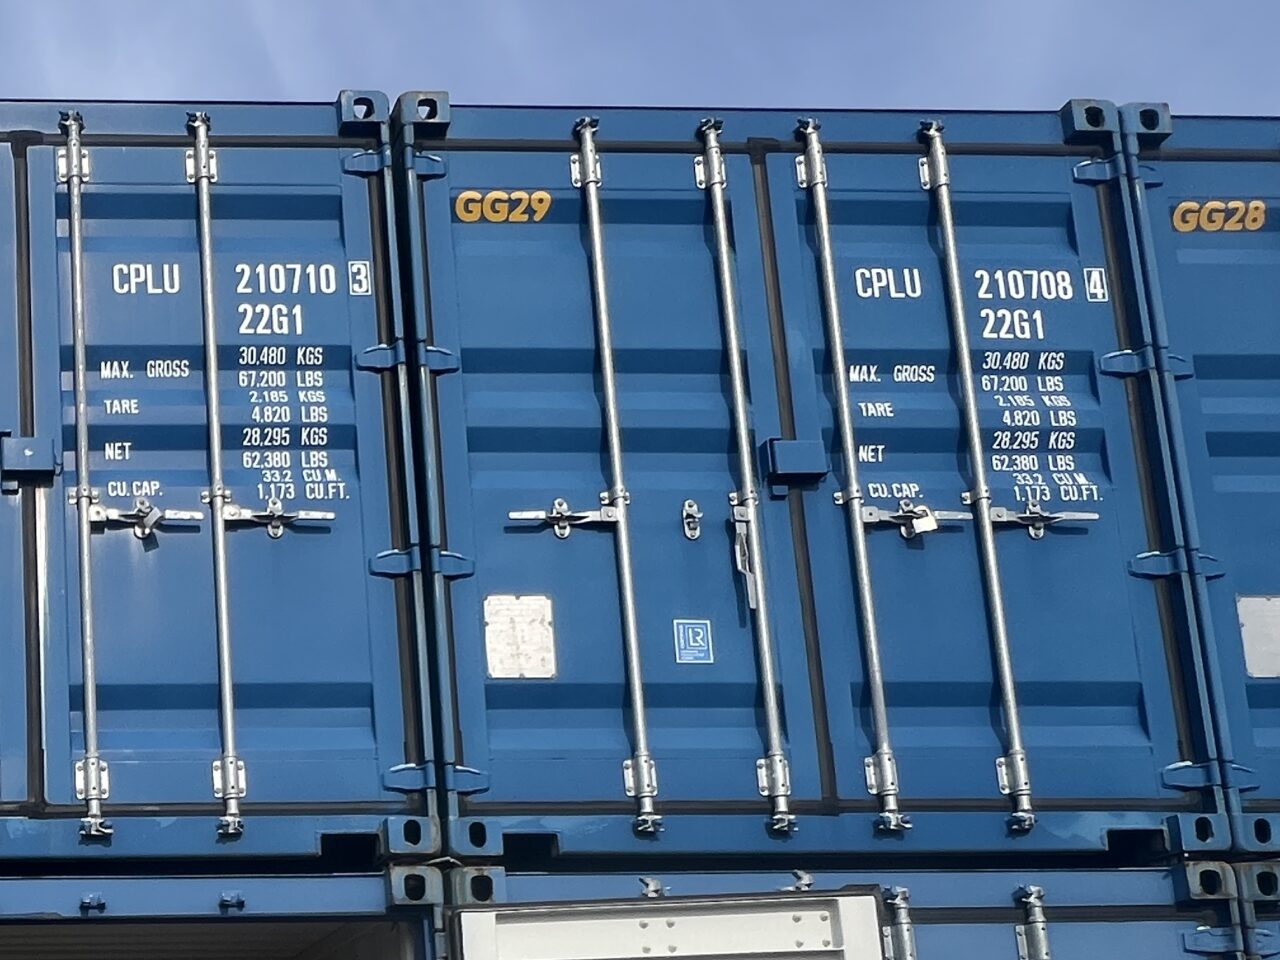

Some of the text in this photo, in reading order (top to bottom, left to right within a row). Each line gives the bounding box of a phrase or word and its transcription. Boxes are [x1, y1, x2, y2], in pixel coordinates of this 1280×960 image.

[456, 192, 551, 221] GG29
[1174, 201, 1265, 231] GG28
[114, 264, 369, 293] CPLU 210710 3
[856, 269, 1105, 300] CPLU 210708 4
[238, 304, 302, 334] 22G1
[981, 309, 1043, 339] 22G1
[297, 347, 322, 364] KGS
[1039, 352, 1064, 370] KGS
[101, 360, 189, 378] MAX. GROSS
[850, 365, 934, 382] MAX. GROSS
[297, 371, 322, 386] LBS
[1038, 376, 1063, 391] LBS
[299, 391, 325, 402] KGS
[1042, 396, 1071, 406] KGS
[104, 400, 138, 413] TARE
[302, 406, 327, 422] LBS
[859, 403, 893, 416] TARE
[1050, 411, 1076, 426] LBS
[302, 427, 327, 445] KGS
[1049, 432, 1075, 449] KGS
[105, 443, 131, 460] NET
[302, 451, 327, 467] LBS
[859, 446, 884, 462] NET
[1048, 455, 1074, 470] LBS
[262, 469, 340, 482] 33.2 CU.M.
[306, 483, 349, 499] CU.FT.
[1060, 485, 1102, 500] CU.FT.
